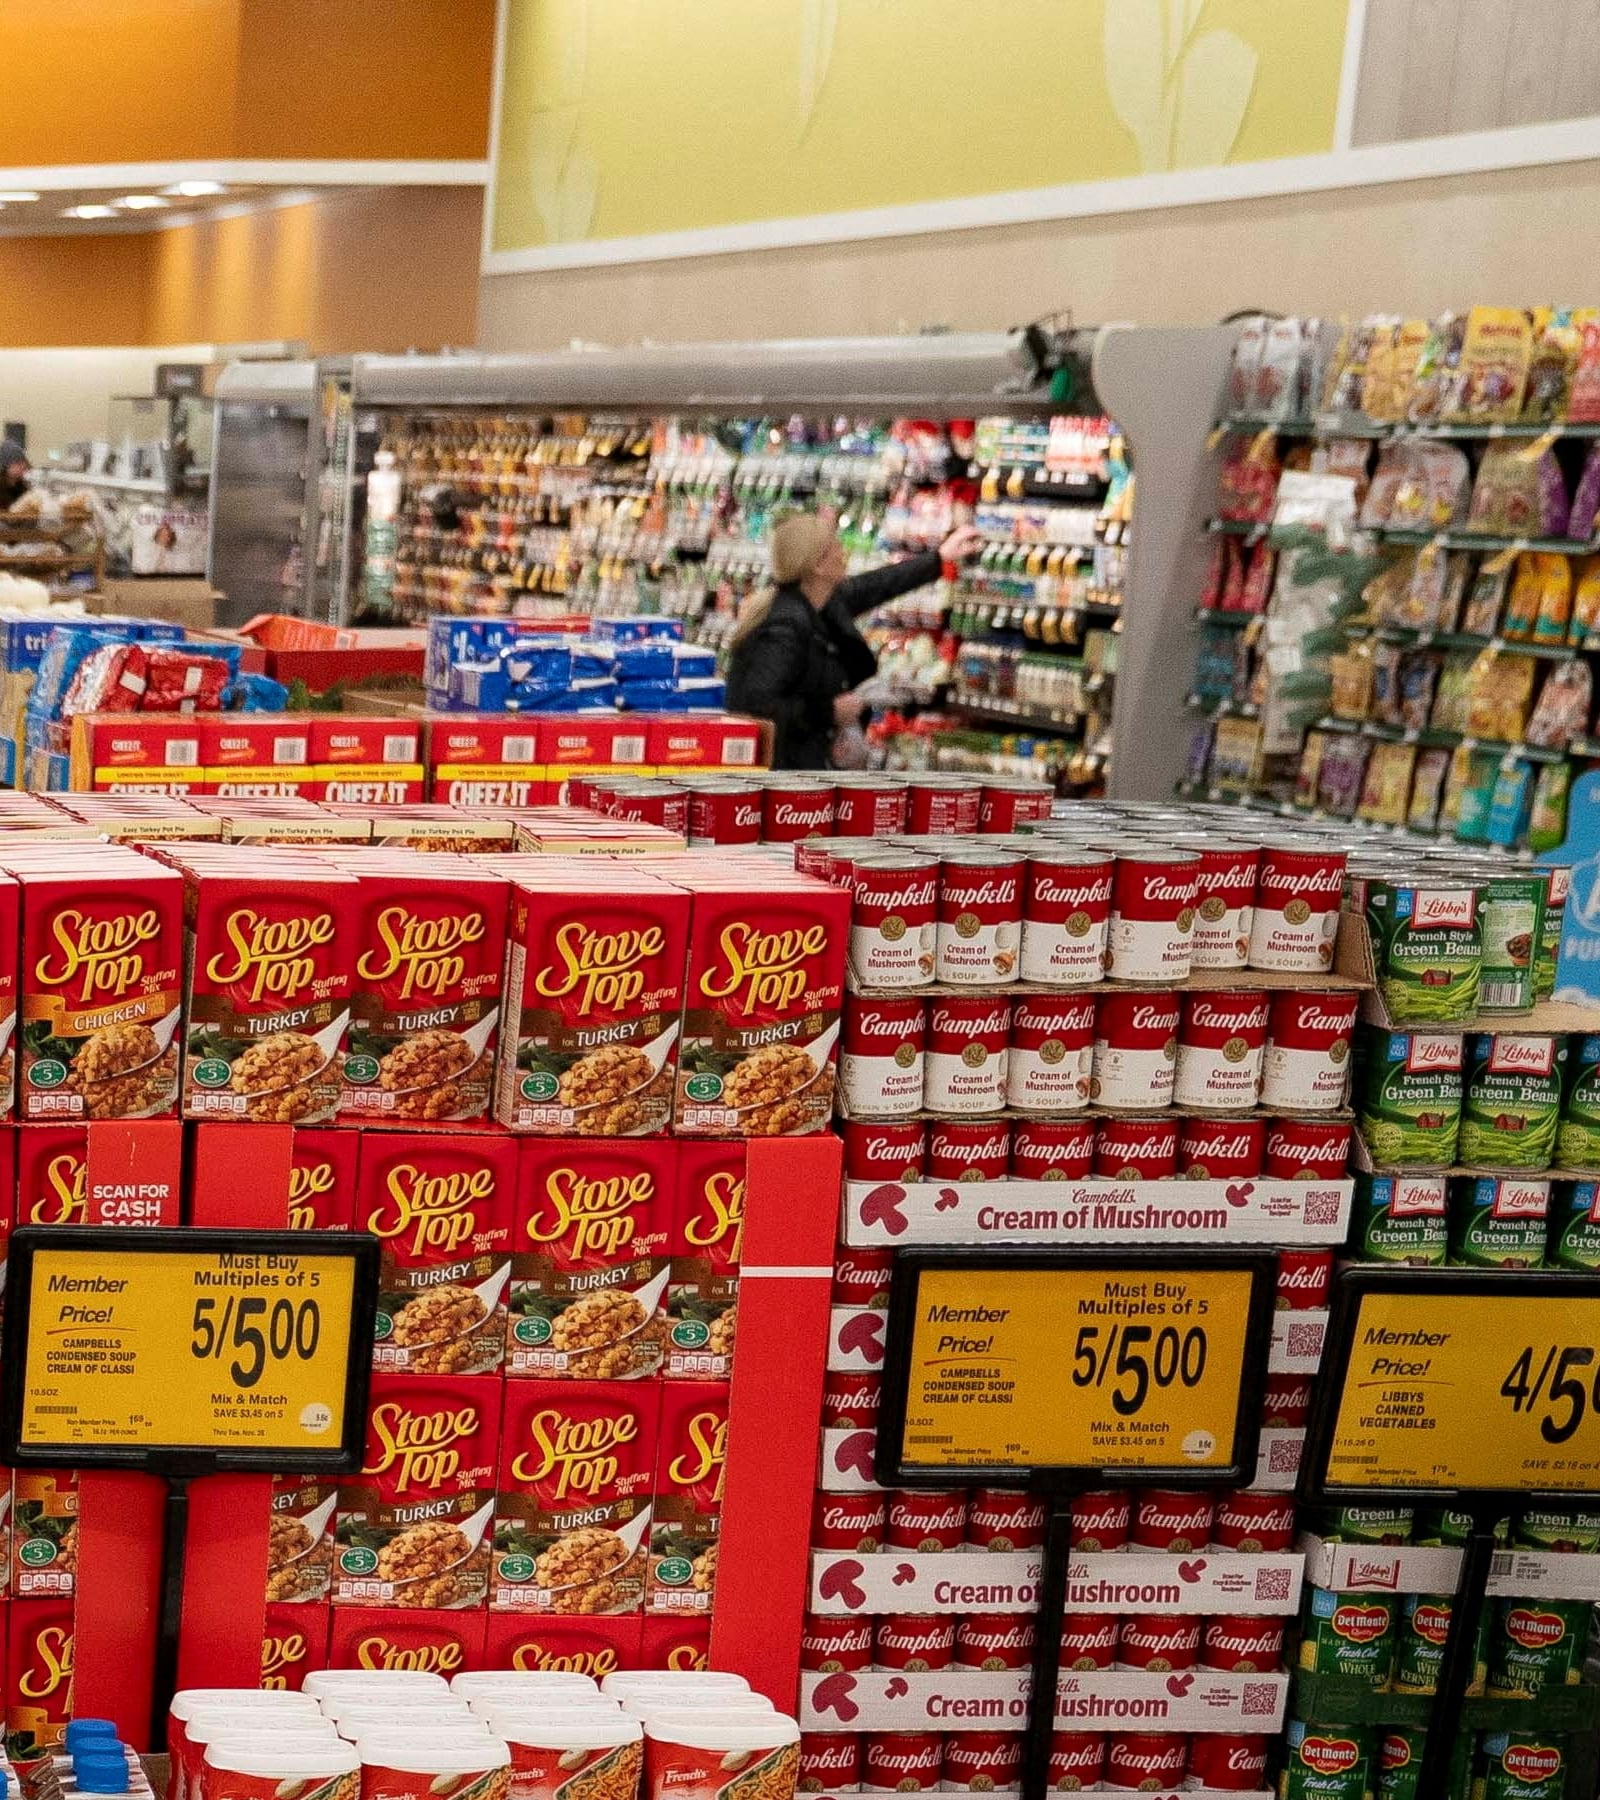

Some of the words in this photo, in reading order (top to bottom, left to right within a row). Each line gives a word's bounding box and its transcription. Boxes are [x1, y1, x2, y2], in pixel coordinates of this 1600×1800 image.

[1421, 898, 1467, 917] Libby's
[206, 908, 335, 983] Stove
[1393, 944, 1438, 956] Green
[1445, 943, 1481, 956] Beans
[248, 953, 315, 1003] Top
[93, 1185, 135, 1199] SCAN
[139, 1185, 169, 1198] FOR
[100, 1200, 160, 1217] CASH
[977, 1206, 1058, 1230] Cream
[1063, 1206, 1086, 1229] of
[1098, 1205, 1227, 1229] Mushroom
[218, 1254, 261, 1269] Must
[266, 1255, 299, 1272] Buy
[194, 1271, 279, 1290] Multiples
[285, 1271, 304, 1286] of
[310, 1273, 320, 1287] 5
[62, 1338, 122, 1349] CAMPBELLS
[46, 1351, 107, 1362] CONDENSED
[109, 1352, 137, 1362] SOUP
[47, 1364, 82, 1374] CREAM
[85, 1364, 98, 1374] OF
[100, 1364, 135, 1374] CLASSI
[211, 1394, 232, 1405] Mix
[236, 1394, 246, 1405] &
[249, 1394, 288, 1405] Match
[1382, 1392, 1424, 1402] LIBBYS
[1375, 1405, 1425, 1416] CANNED
[1359, 1417, 1436, 1429] VEGETABLES
